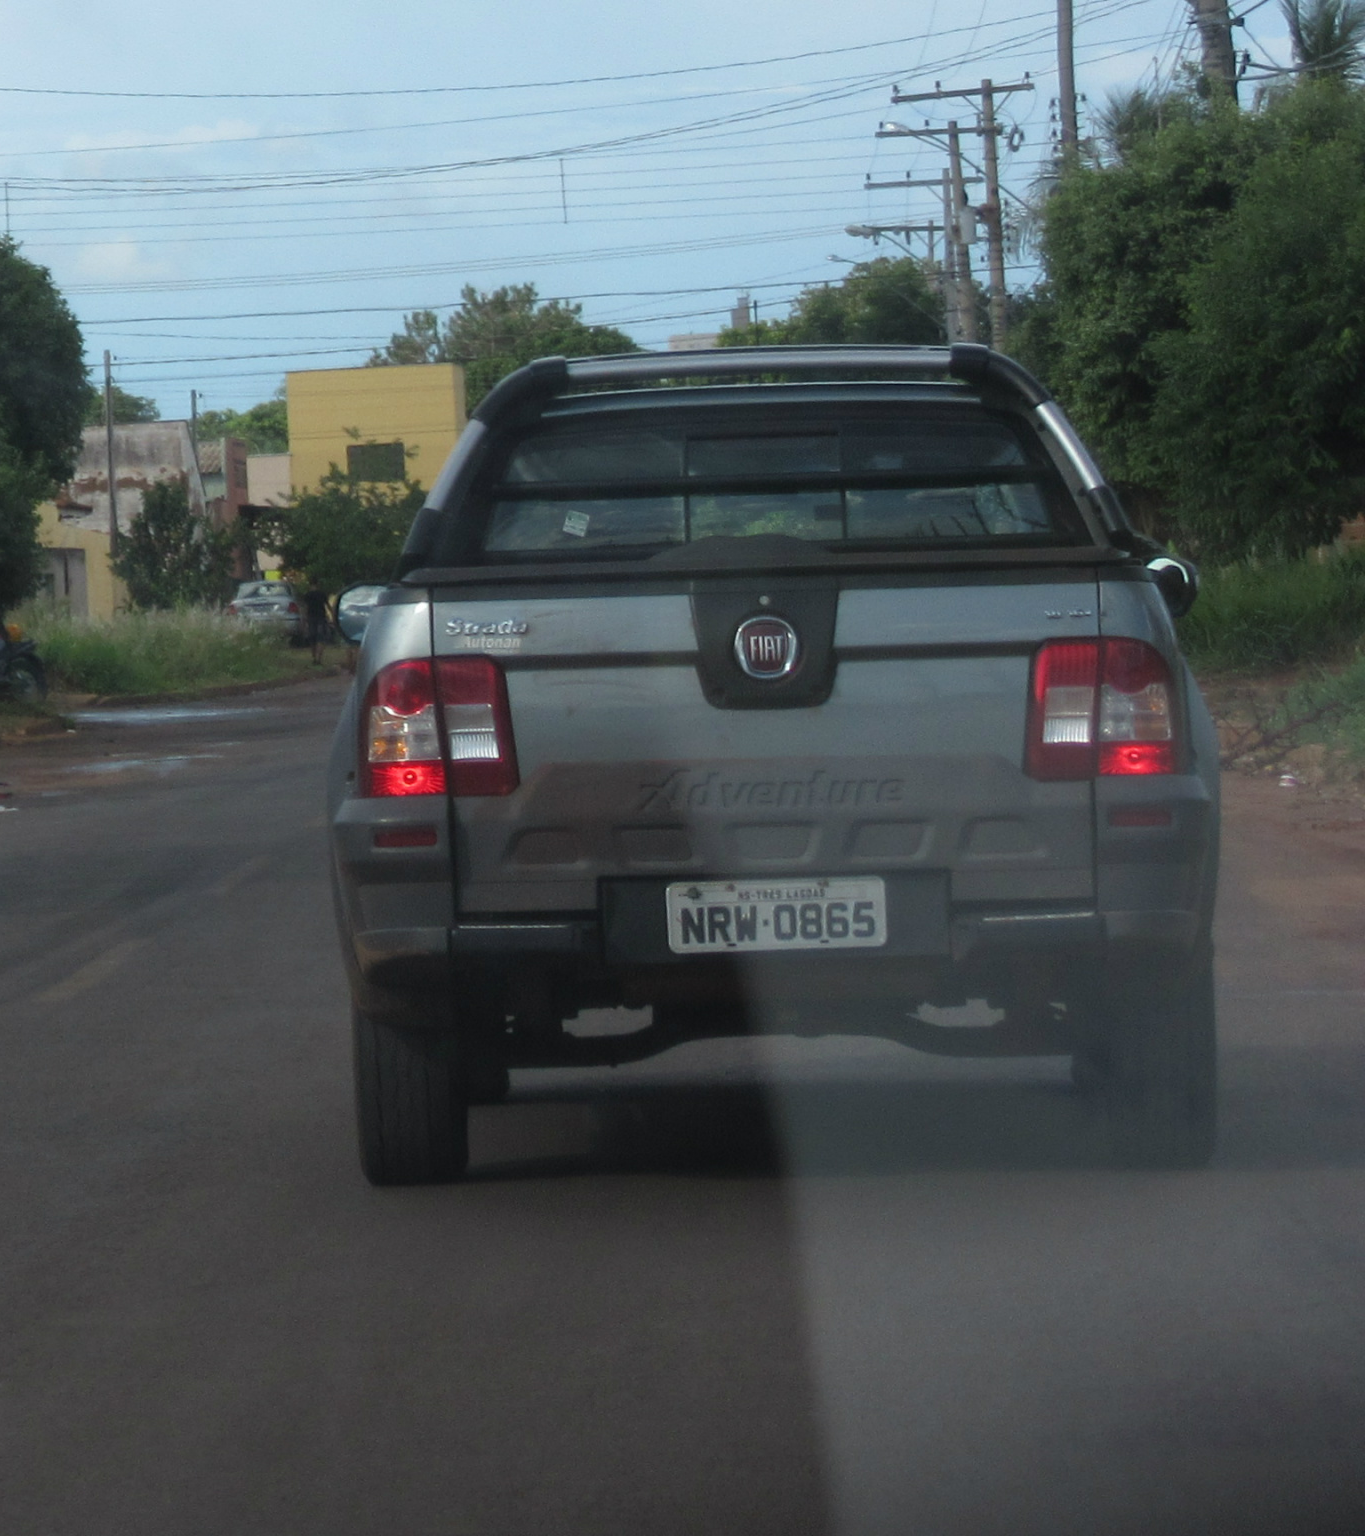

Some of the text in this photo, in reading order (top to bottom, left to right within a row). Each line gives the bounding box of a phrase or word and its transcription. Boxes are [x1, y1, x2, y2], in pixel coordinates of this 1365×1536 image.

[445, 617, 528, 635] Strada
[749, 635, 784, 662] FIAT
[638, 768, 906, 811] Adventure
